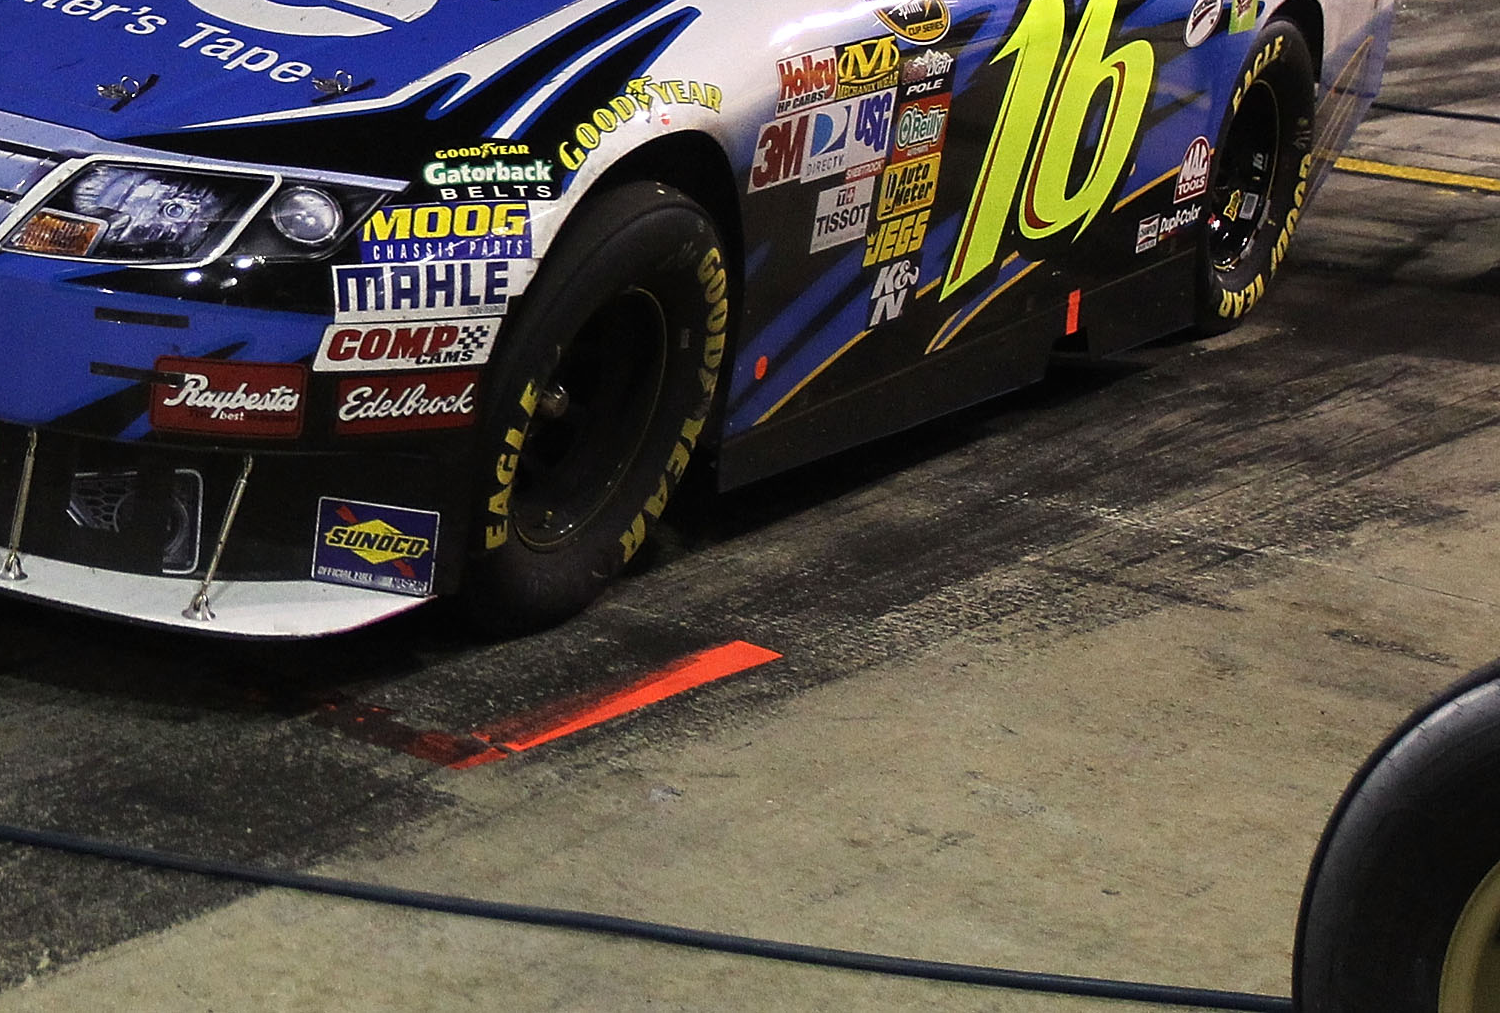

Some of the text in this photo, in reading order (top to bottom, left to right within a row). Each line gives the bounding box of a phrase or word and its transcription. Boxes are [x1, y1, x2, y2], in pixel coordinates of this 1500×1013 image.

[908, 20, 945, 36] CUP SERIES
[178, 22, 312, 84] Tape
[926, 58, 954, 77] LIGHT
[777, 54, 837, 100] Holley
[906, 79, 944, 96] POLE
[1233, 34, 1284, 115] EAGLE
[777, 93, 826, 114] HP CARBS
[560, 75, 723, 172] GOODYEAR
[855, 92, 893, 153] USG
[898, 107, 946, 148] O'Reilly
[435, 143, 530, 159] GOODYEAR
[752, 115, 810, 188] 3M
[806, 155, 845, 176] DIRECTV
[1178, 142, 1208, 184] MAC
[423, 159, 553, 186] Gatorback
[900, 162, 930, 186] Auto
[1178, 176, 1206, 195] TOOLS
[440, 185, 553, 201] BELTS
[892, 181, 933, 211] Meter
[362, 203, 528, 242] MOOG
[816, 203, 870, 236] TISSOT
[372, 239, 525, 261] CHASSIS PARTS
[862, 210, 932, 268] JEGS
[336, 262, 509, 313] MAHLE
[327, 326, 459, 362] COMP
[414, 349, 476, 366] CAMS
[163, 373, 300, 419] Raybestos
[338, 382, 477, 422] Edelbrock
[219, 410, 245, 421] best
[485, 379, 541, 550] EAGLE
[329, 527, 428, 559] SUNOCO
